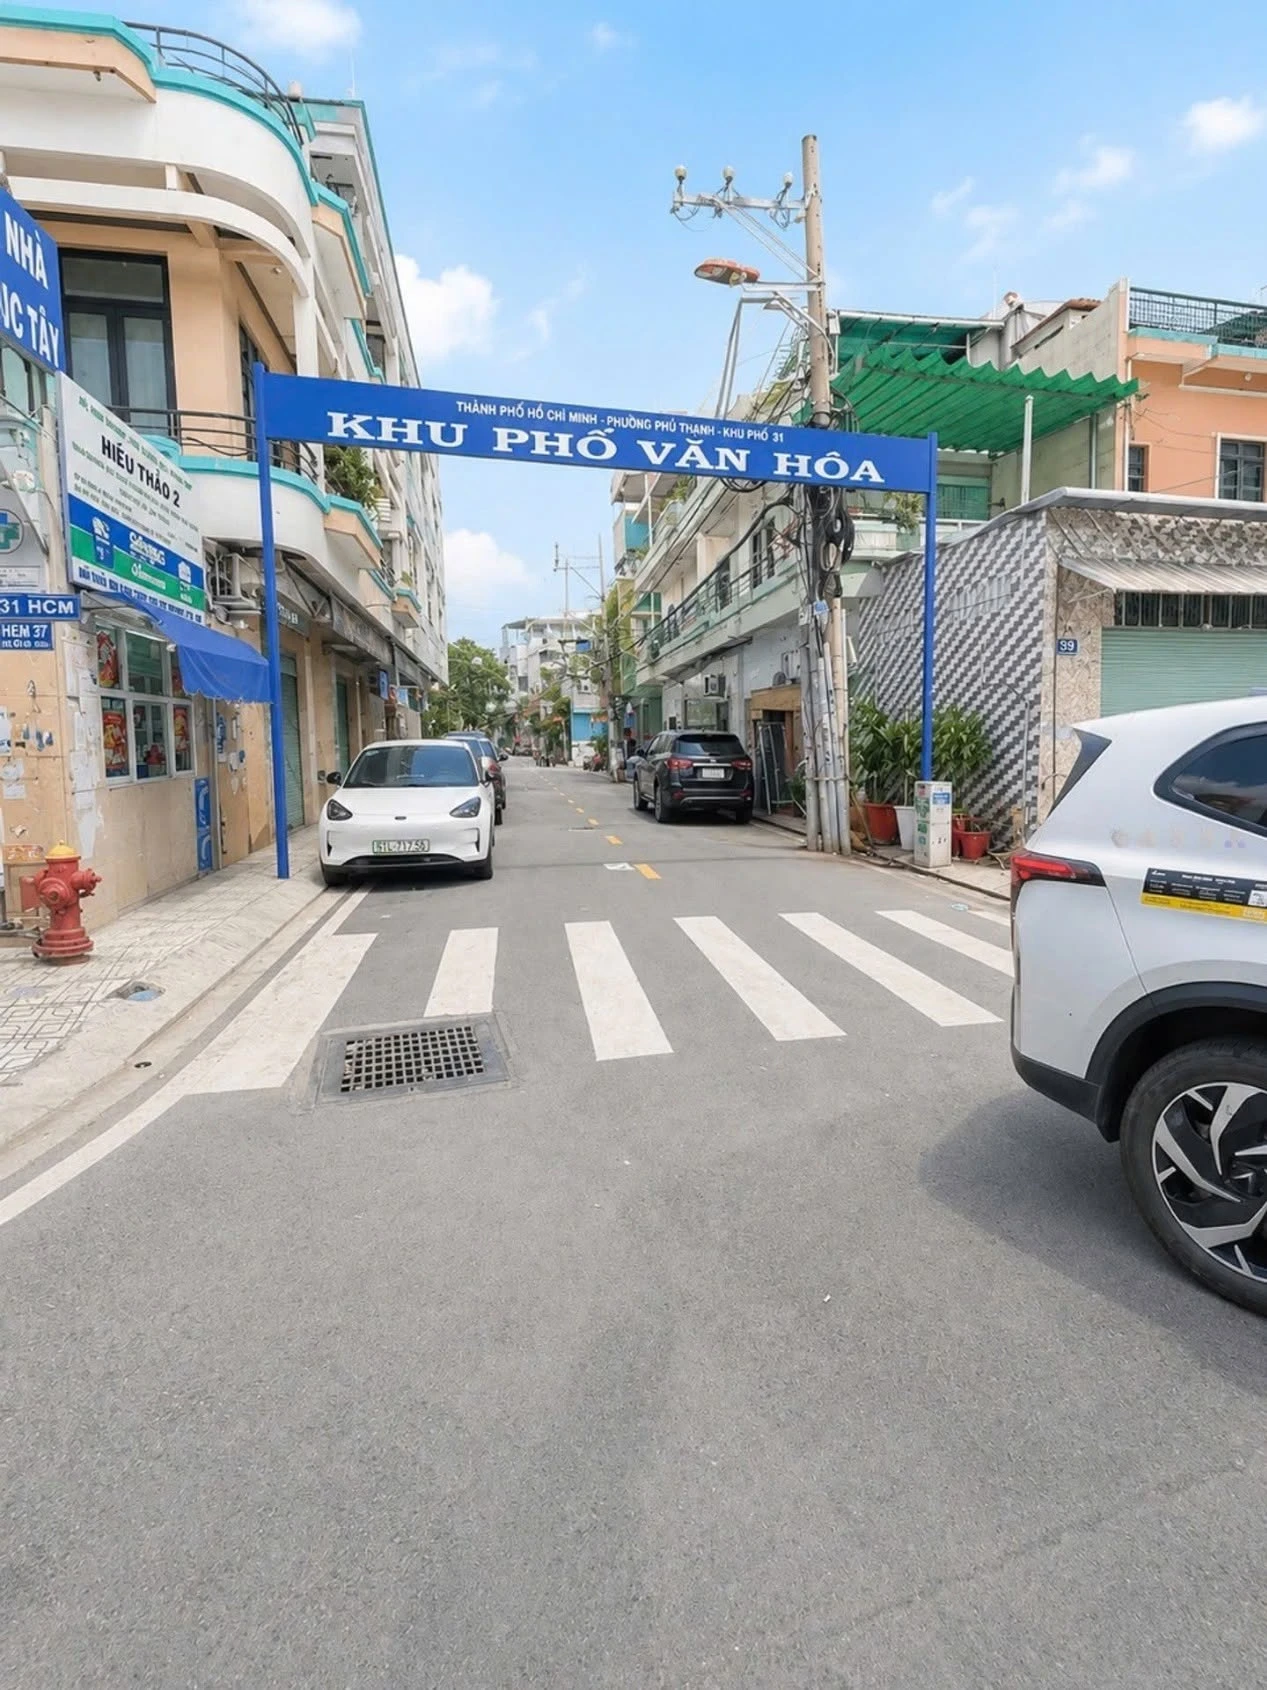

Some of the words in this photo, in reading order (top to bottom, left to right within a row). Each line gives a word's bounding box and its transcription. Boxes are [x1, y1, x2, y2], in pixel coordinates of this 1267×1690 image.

[4, 210, 49, 290] NHÀ
[568, 411, 598, 425] MINH
[723, 427, 745, 439] KHU
[772, 432, 784, 443] 31
[326, 411, 468, 448] KHU
[492, 426, 618, 461] PHỐ
[636, 438, 751, 472] VĂN
[173, 490, 180, 508] 2
[0, 598, 20, 614] 31
[28, 599, 74, 614] HCM
[33, 624, 48, 638] 37
[1059, 639, 1075, 651] 99
